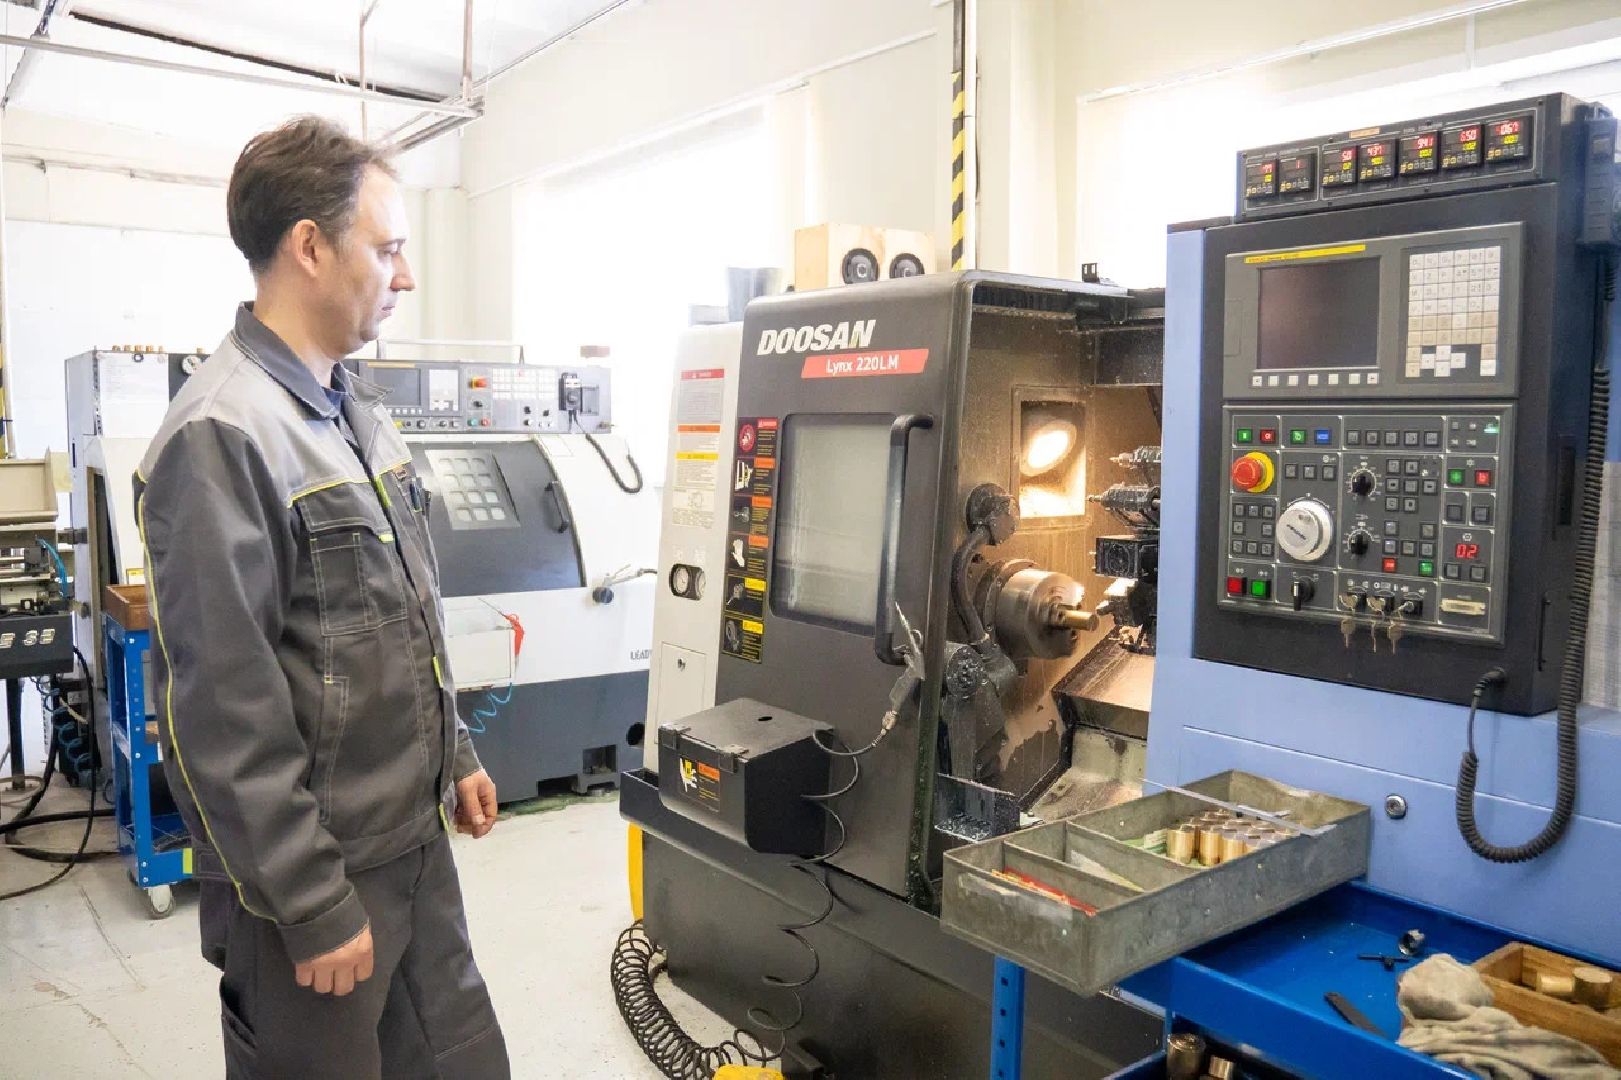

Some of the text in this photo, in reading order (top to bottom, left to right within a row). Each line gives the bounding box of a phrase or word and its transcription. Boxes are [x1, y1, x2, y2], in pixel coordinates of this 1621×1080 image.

[756, 319, 877, 356] DOOSAN
[826, 355, 899, 377] Lynx 220LM
[1456, 543, 1478, 559] 02
